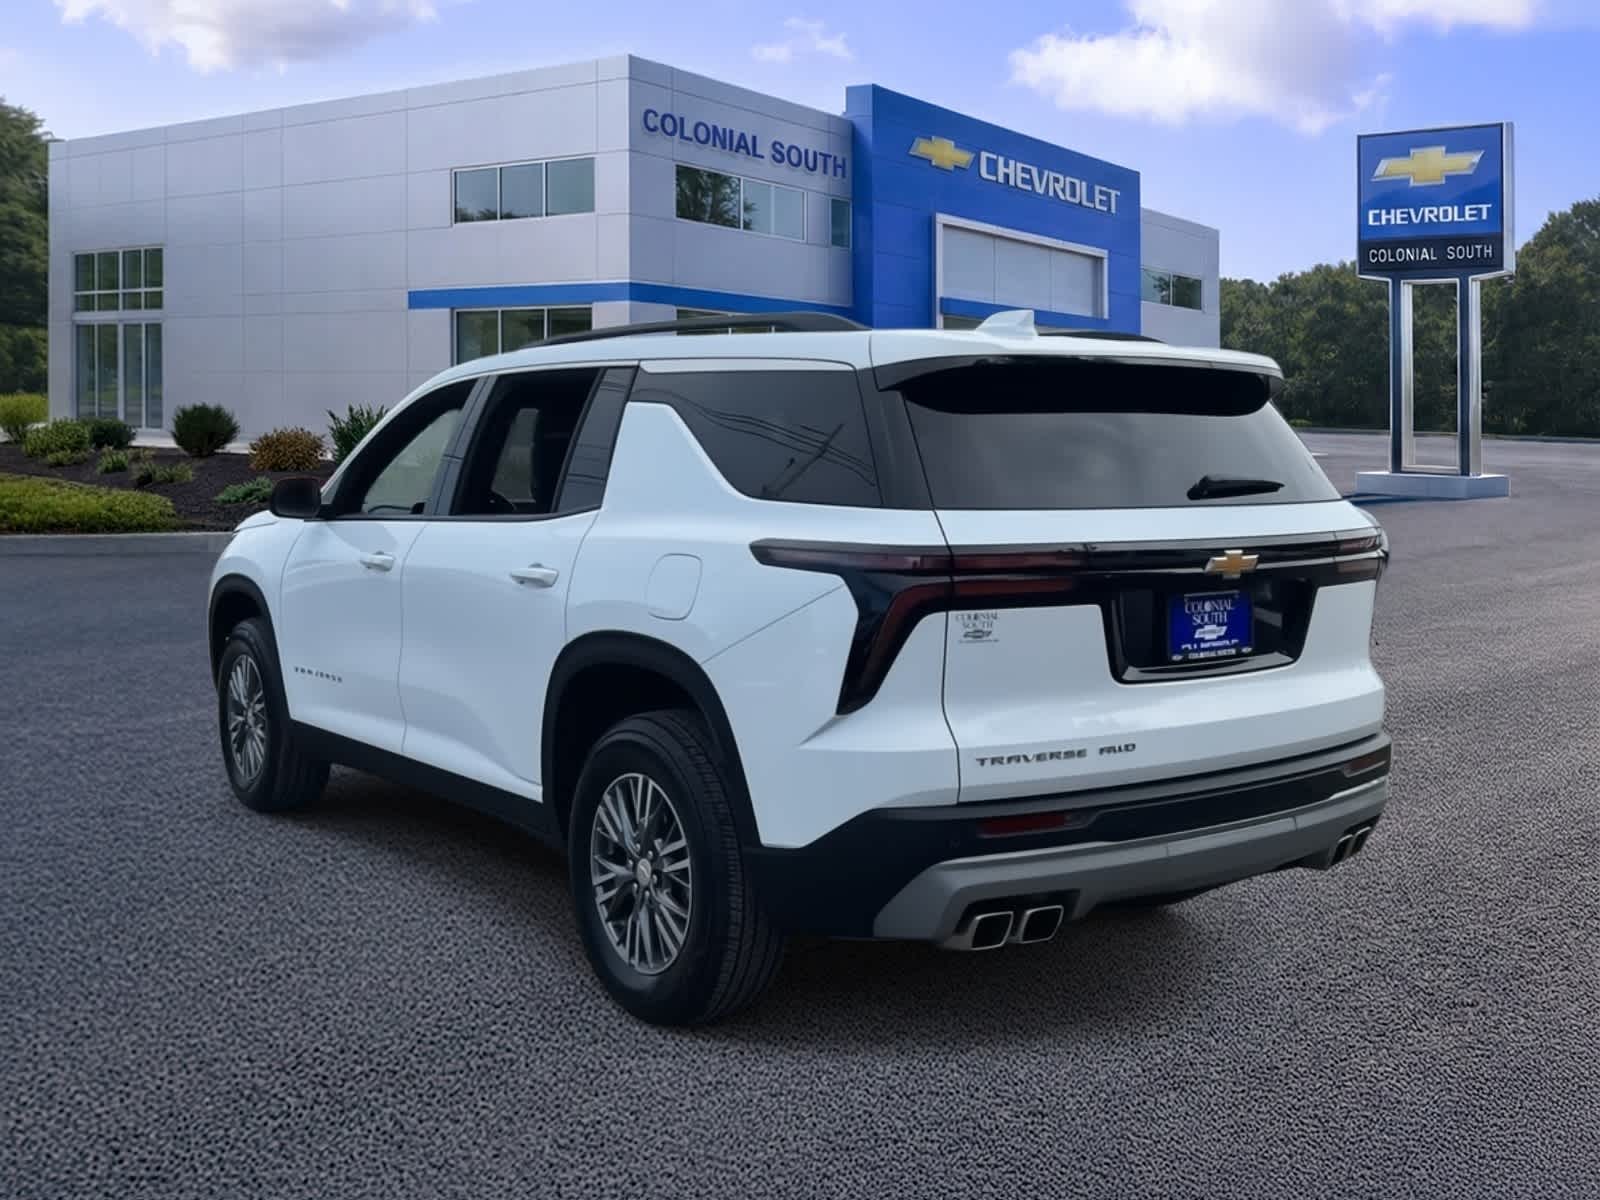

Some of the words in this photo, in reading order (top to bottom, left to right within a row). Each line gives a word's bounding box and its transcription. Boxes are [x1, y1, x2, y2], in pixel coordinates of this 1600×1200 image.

[643, 109, 765, 160] COLONIAL
[771, 140, 848, 179] SOUTH
[978, 150, 1121, 215] CHEVROLET
[1368, 203, 1492, 226] CHEVROLET
[1369, 247, 1437, 263] COLONIAL
[1447, 244, 1493, 260] SOUTH
[1184, 599, 1235, 614] COLONIAL
[1192, 611, 1228, 626] SOUTH
[976, 749, 1087, 767] TRAVERSE
[1098, 742, 1137, 756] AWD
